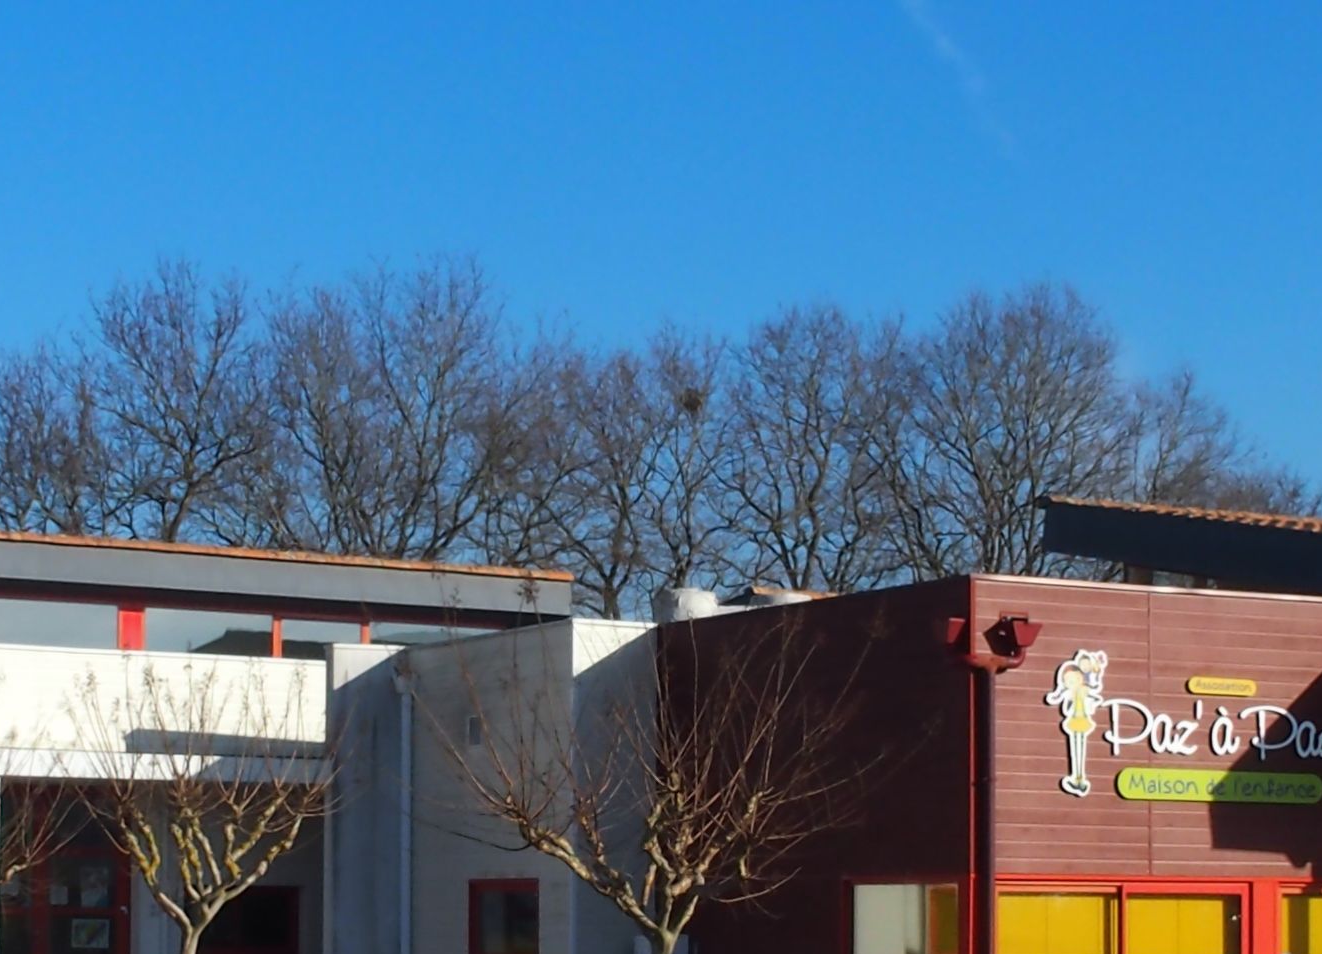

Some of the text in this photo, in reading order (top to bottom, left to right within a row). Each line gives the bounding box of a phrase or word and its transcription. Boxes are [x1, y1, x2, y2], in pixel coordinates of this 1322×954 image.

[1101, 698, 1203, 756] Paz'
[1210, 706, 1240, 756] à
[1128, 774, 1317, 799] Maison de l'enfance
